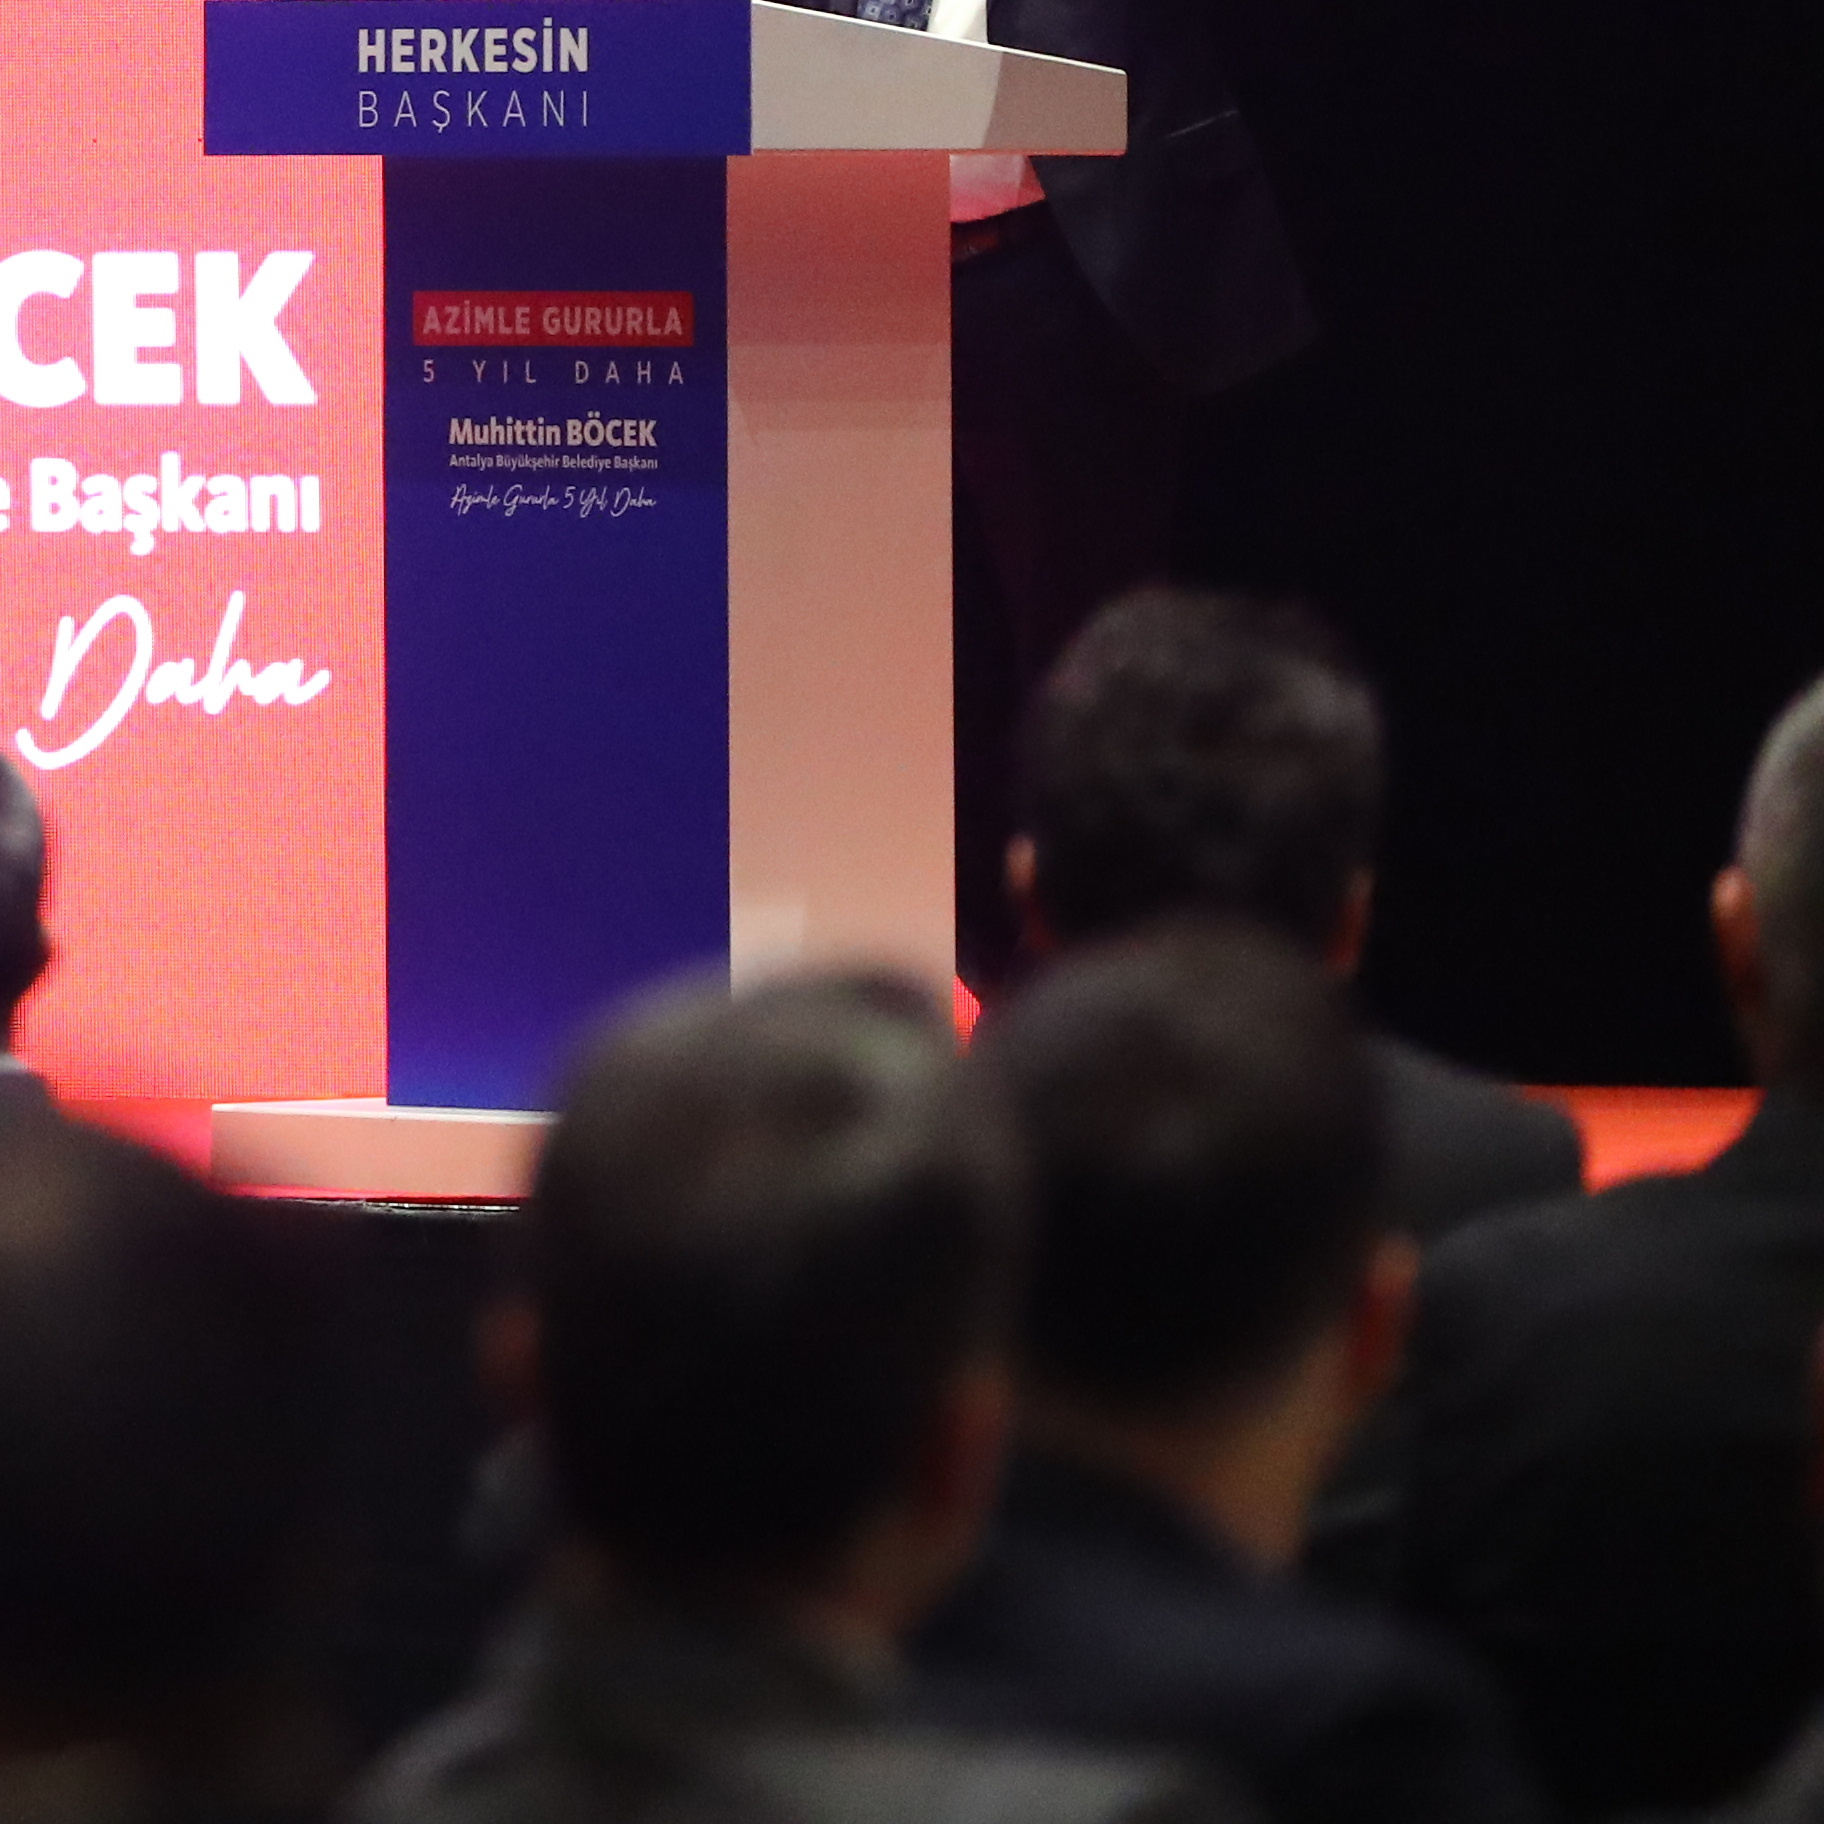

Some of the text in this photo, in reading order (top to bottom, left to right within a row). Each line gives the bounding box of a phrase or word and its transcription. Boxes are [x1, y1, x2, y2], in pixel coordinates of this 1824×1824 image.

[358, 17, 589, 73] HERKESİN
[358, 90, 588, 133] BAŞKANI
[422, 300, 683, 336] AZİMLE GURURLA
[423, 359, 684, 385] 5 YIL DAHA
[449, 411, 657, 447] Muhittin BÖCEK
[450, 453, 658, 473] Antalya Büyükşehir Belediye Başkanı
[29, 451, 321, 557] Başkanı
[563, 485, 577, 509] 5
[610, 486, 657, 517] Daha
[14, 589, 334, 771] Daha
